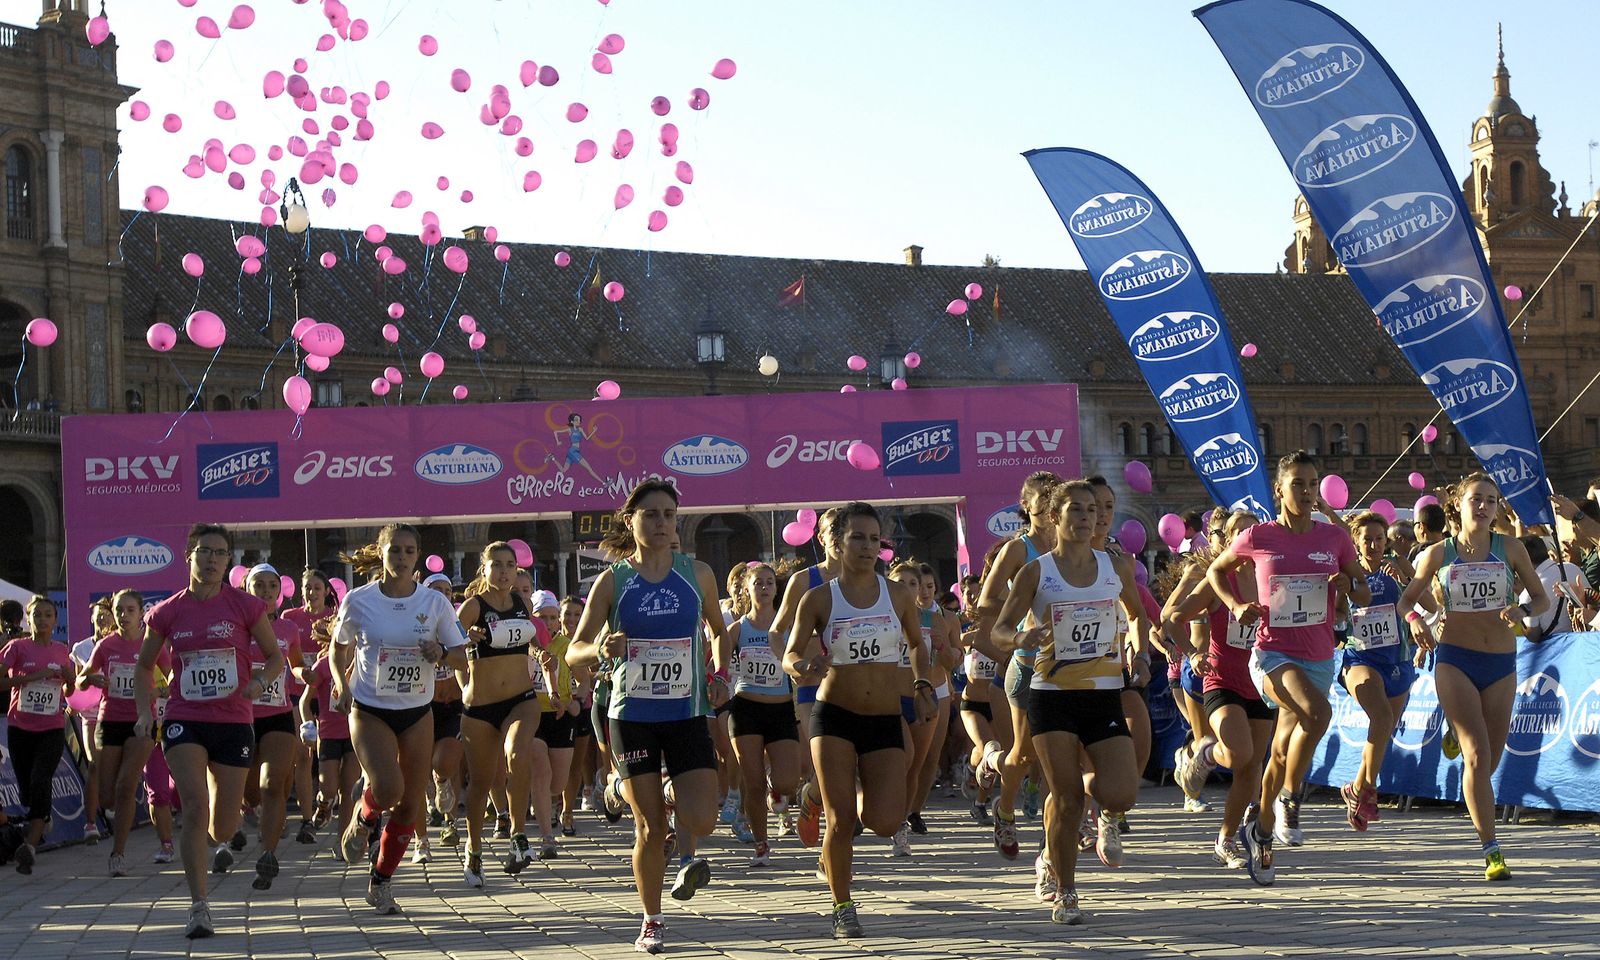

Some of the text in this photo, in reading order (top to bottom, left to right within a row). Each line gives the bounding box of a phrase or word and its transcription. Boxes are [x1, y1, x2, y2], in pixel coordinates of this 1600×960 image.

[889, 428, 951, 461] Buckler
[976, 429, 1064, 454] DKV
[670, 450, 742, 466] ASTURIANA
[977, 454, 1065, 467] SEGUROS MÉDICOS
[85, 456, 180, 481] DKV
[204, 450, 271, 484] Buckler
[422, 460, 496, 474] ASTURIANA
[86, 482, 180, 495] SEGUROS MÉDICOS
[94, 552, 167, 566] ASTURIANA
[1461, 581, 1496, 598] 1705
[1297, 595, 1302, 611] 1
[508, 629, 521, 642] 13
[1072, 622, 1101, 642] 627
[1239, 625, 1255, 639] 17
[1361, 621, 1389, 637] 3104
[849, 639, 880, 659] 566
[388, 666, 421, 681] 2993
[641, 663, 682, 681] 1709
[747, 661, 776, 675] 3170
[978, 661, 996, 670] 367
[191, 668, 227, 685] 1098
[27, 691, 53, 704] 5369
